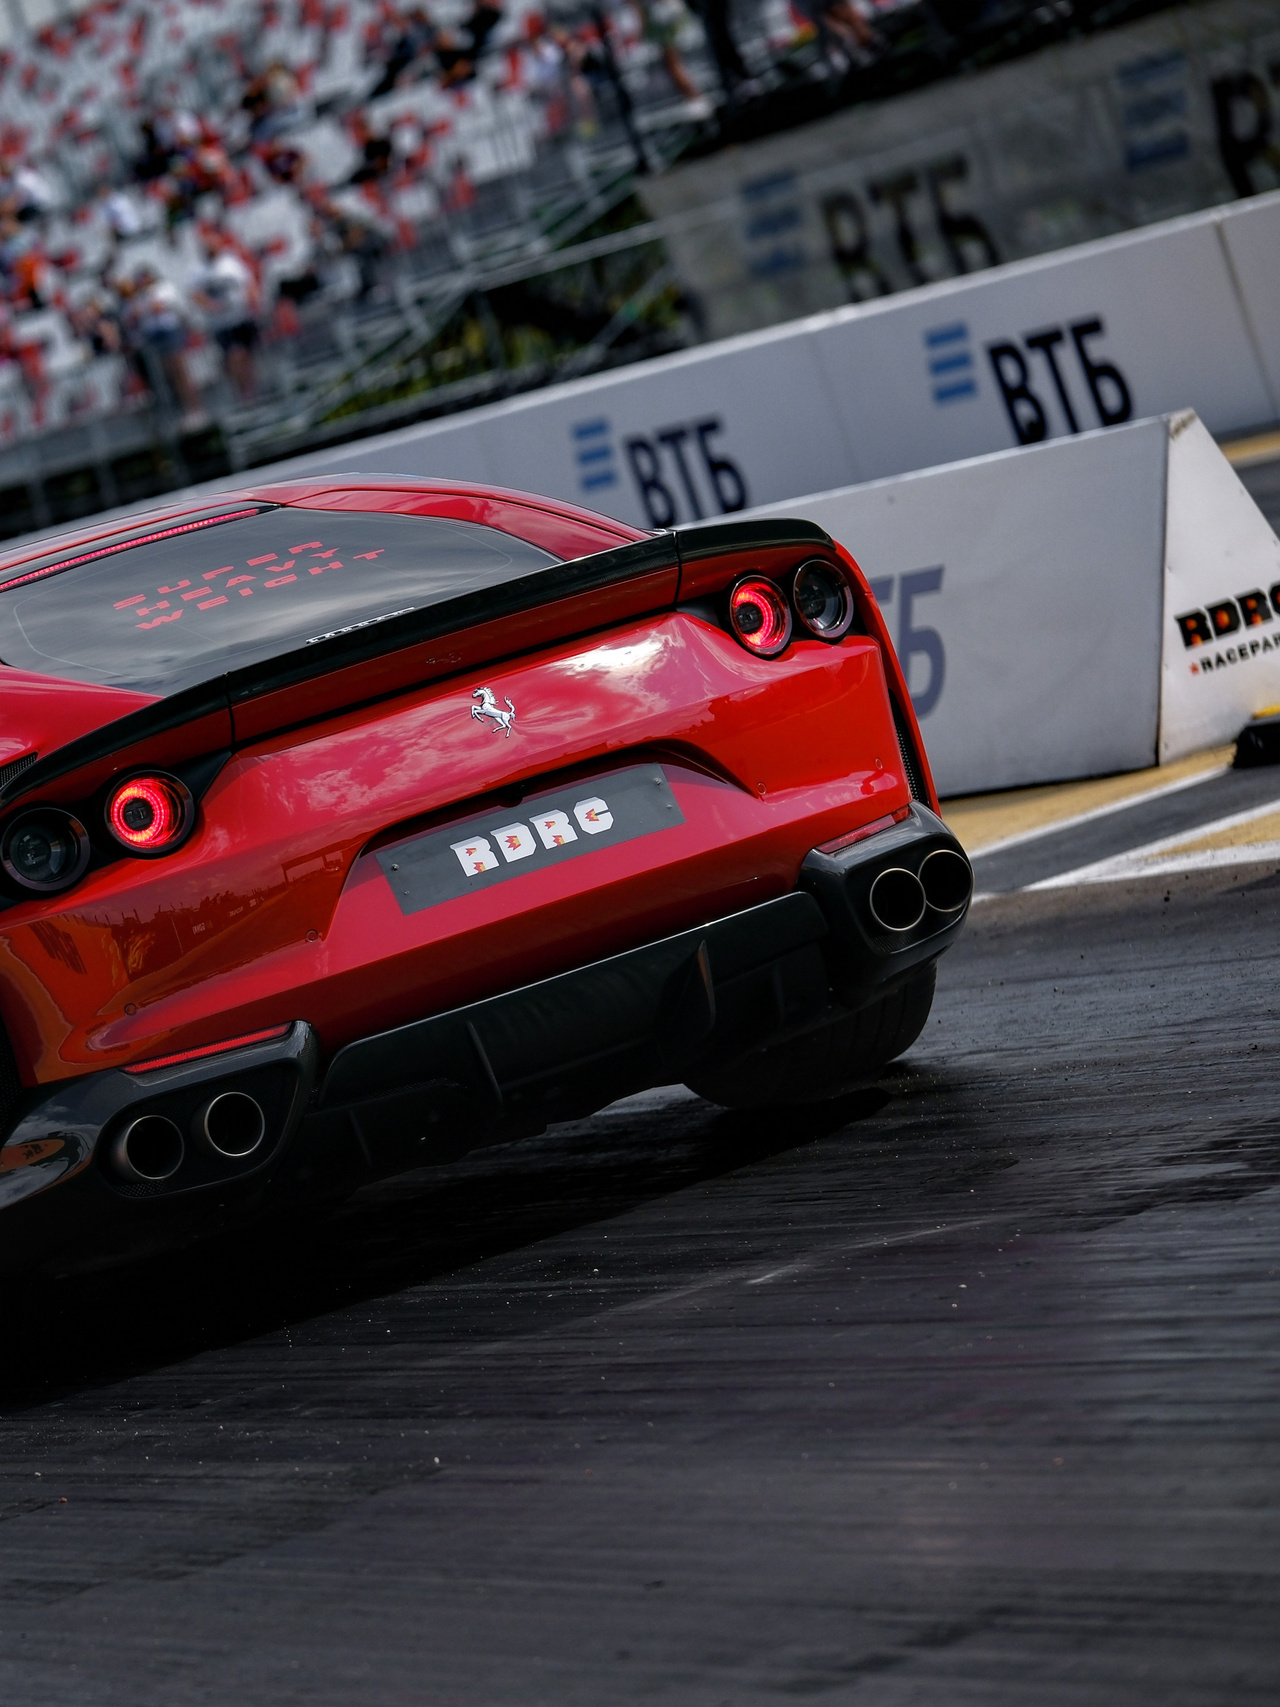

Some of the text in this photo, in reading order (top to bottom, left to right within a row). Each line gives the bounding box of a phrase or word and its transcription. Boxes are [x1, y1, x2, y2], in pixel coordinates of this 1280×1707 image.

[985, 313, 1132, 445] ВТБ
[623, 414, 747, 528] ВТБ
[113, 541, 323, 610] SUPER
[135, 549, 385, 629] WEIGHT
[136, 547, 340, 616] HEAVY
[450, 796, 614, 877] RDRC
